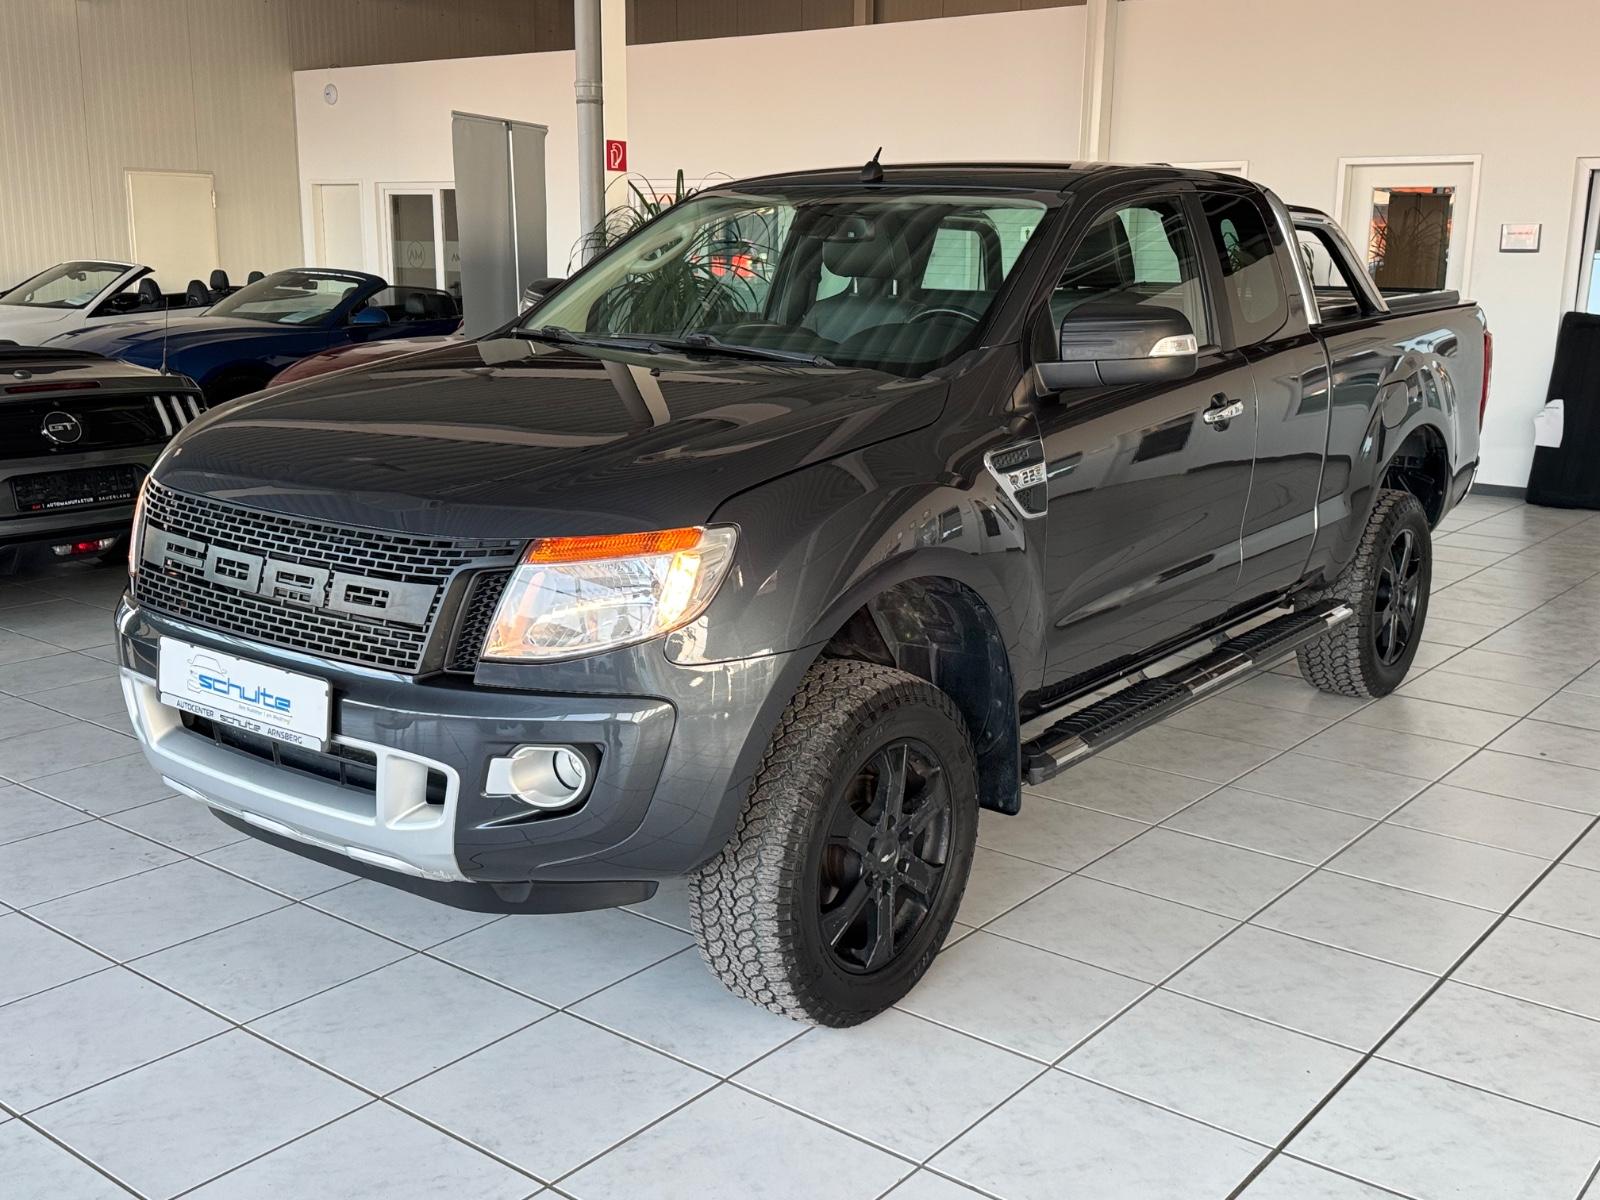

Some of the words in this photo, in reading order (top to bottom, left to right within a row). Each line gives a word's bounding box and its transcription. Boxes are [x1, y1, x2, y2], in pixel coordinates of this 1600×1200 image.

[49, 422, 75, 431] GT
[143, 523, 439, 625] FORD
[198, 674, 291, 713] schulte
[176, 699, 214, 718] AUTOCENTER
[267, 728, 303, 744] ARNSBERG
